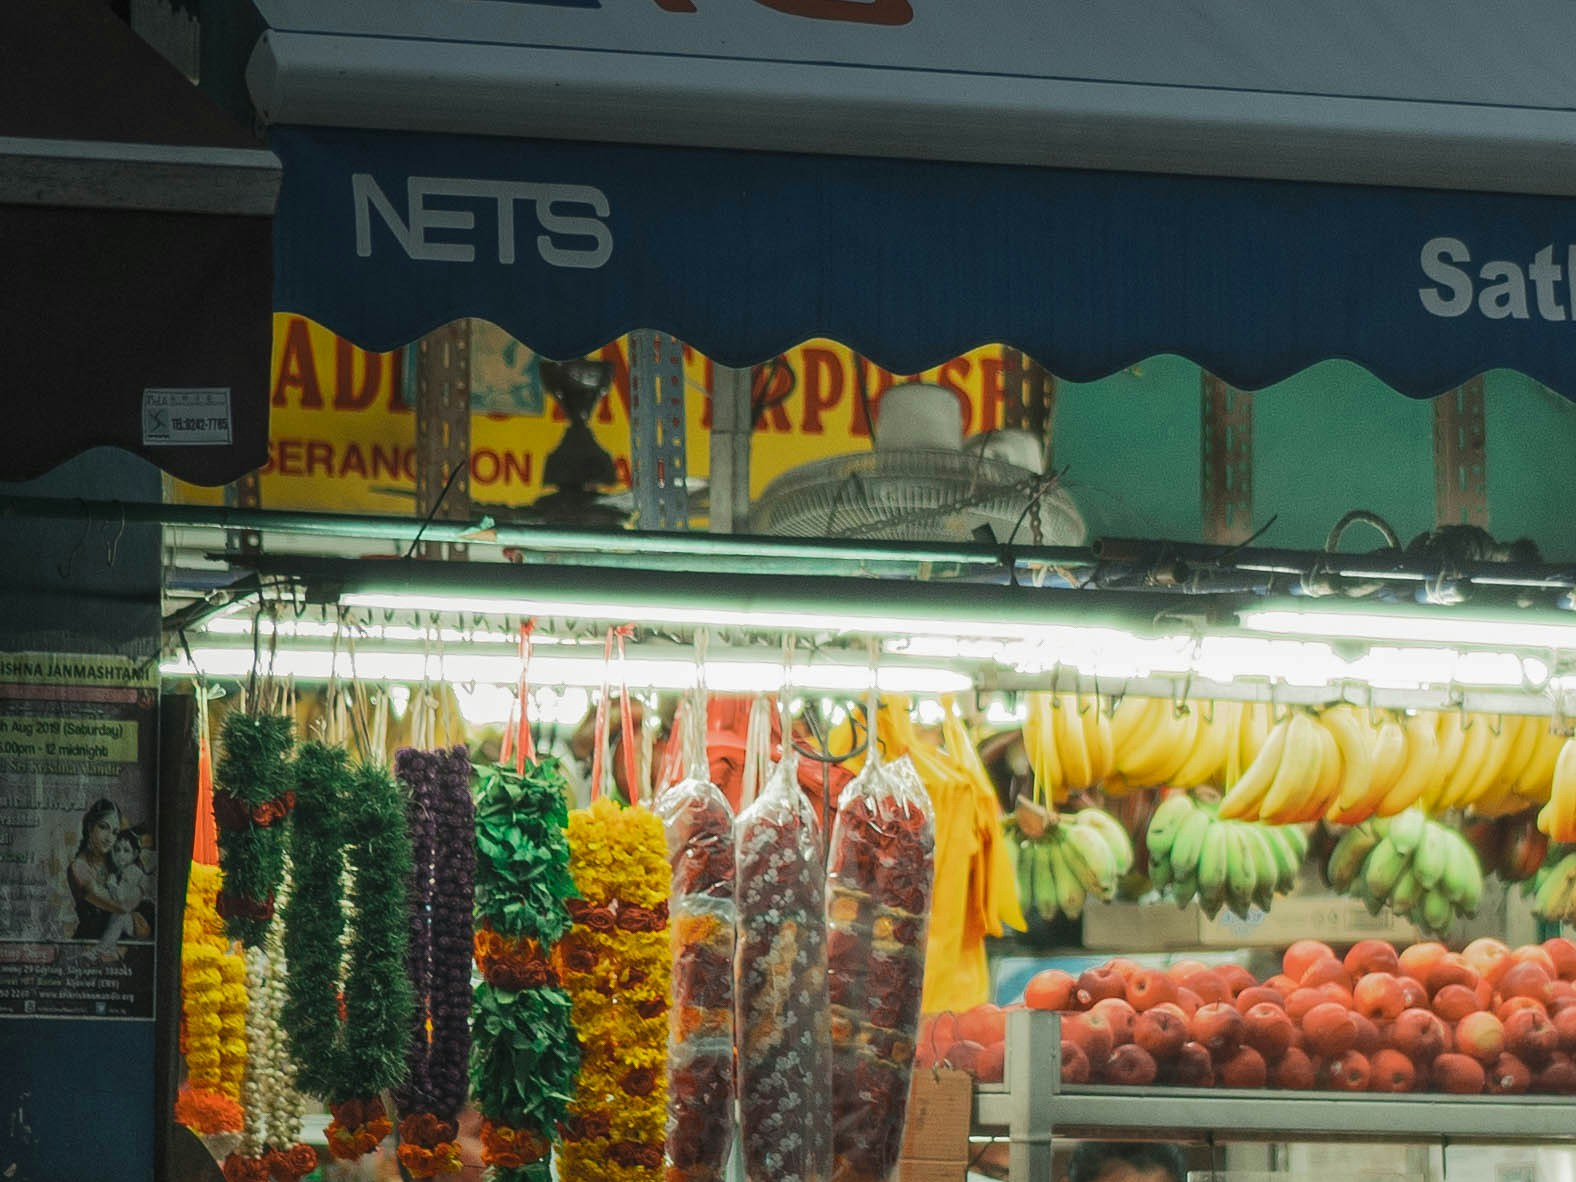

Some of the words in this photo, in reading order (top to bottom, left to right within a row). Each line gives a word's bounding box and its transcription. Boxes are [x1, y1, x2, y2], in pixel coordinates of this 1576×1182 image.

[352, 173, 613, 269] NETS
[258, 438, 532, 488] SERANON
[12, 721, 33, 736] Aug
[63, 722, 123, 740] (Saturday)
[59, 744, 108, 760] midnight
